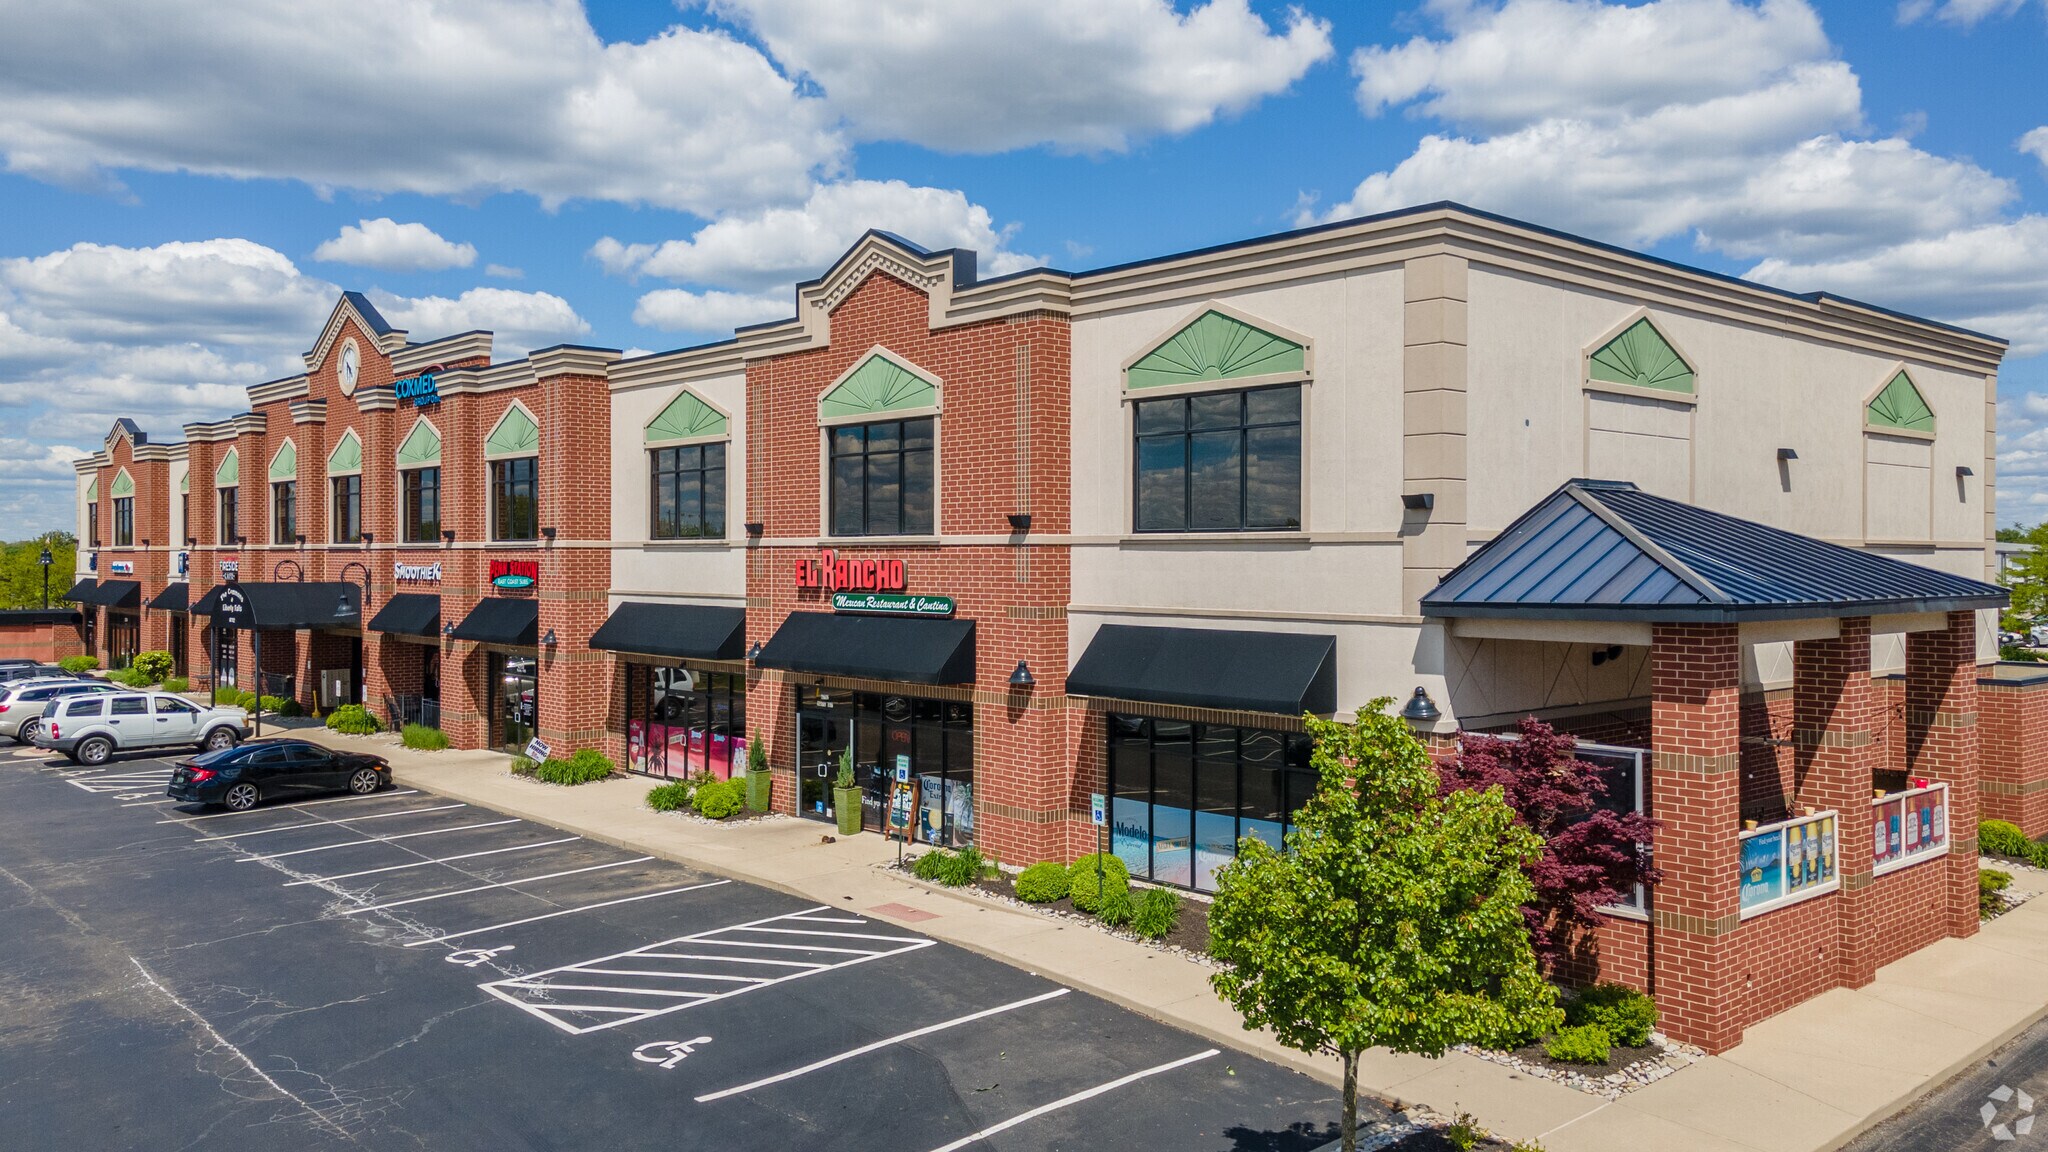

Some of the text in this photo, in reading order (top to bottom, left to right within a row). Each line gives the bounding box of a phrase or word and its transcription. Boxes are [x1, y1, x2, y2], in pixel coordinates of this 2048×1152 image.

[795, 559, 818, 587] EL
[835, 594, 949, 611] Mexican Restaurant & Cantina
[529, 744, 547, 757] HIRING
[535, 740, 549, 750] NOW
[1116, 821, 1147, 840] Modelo
